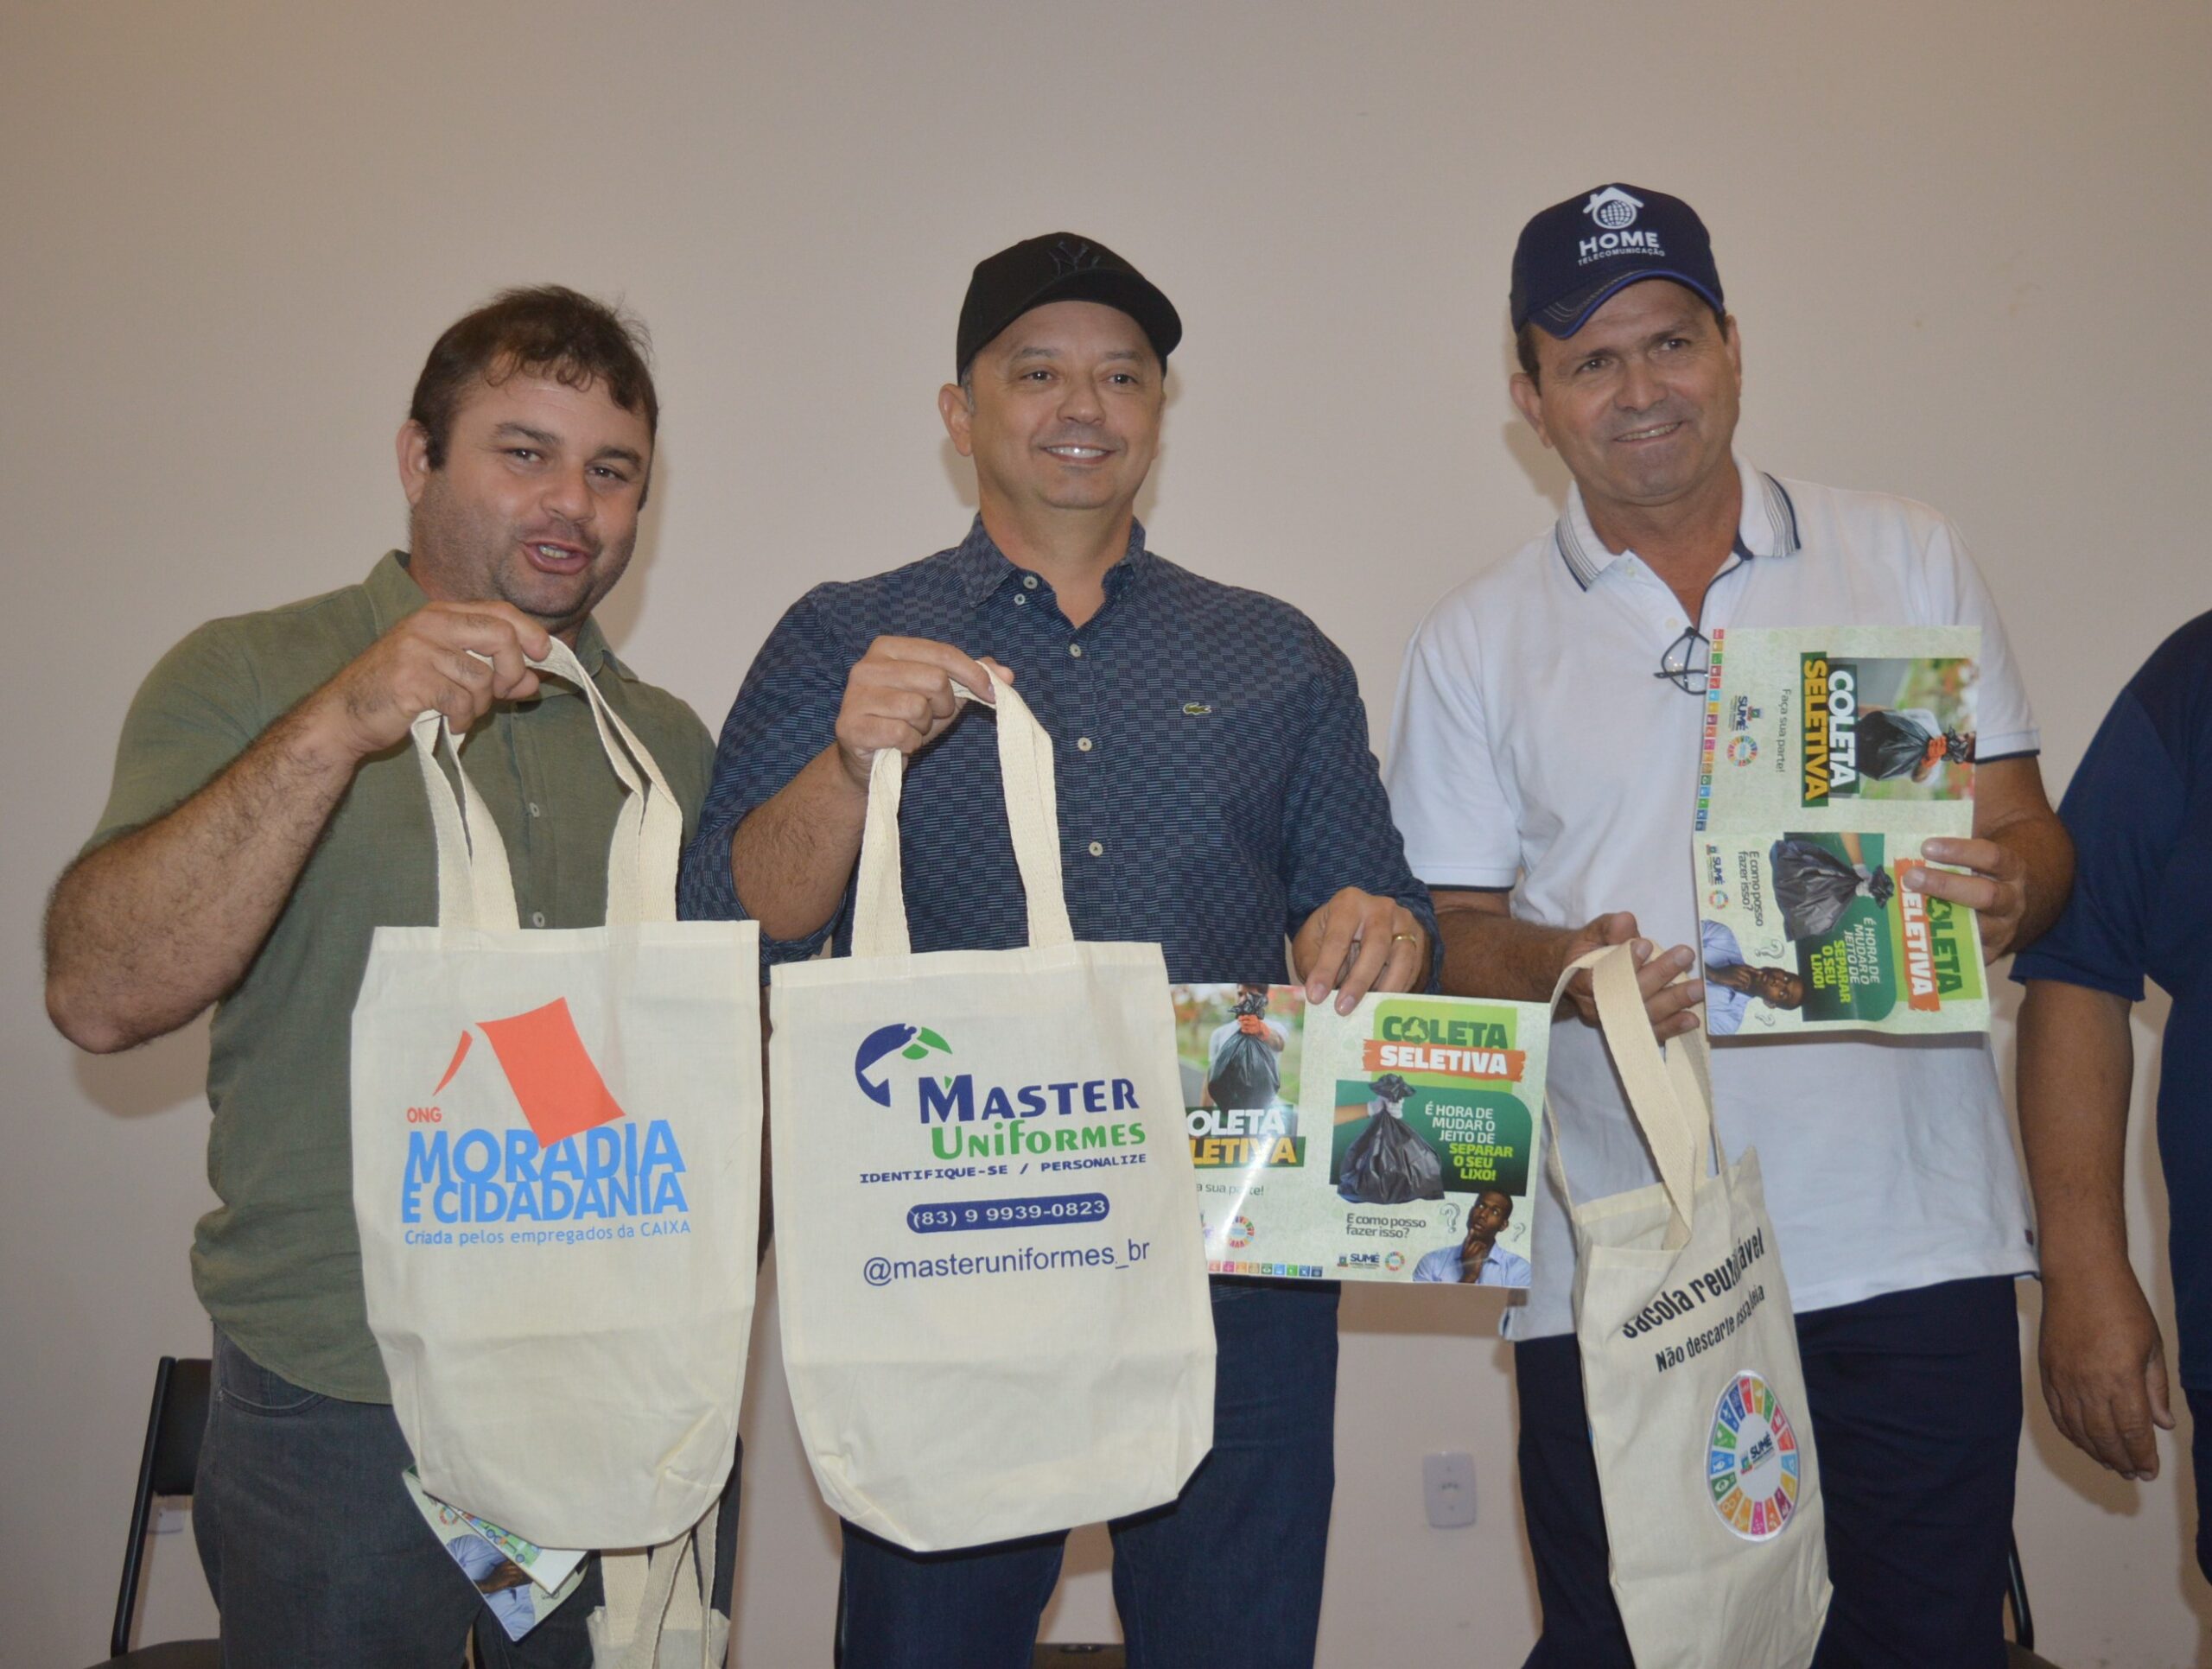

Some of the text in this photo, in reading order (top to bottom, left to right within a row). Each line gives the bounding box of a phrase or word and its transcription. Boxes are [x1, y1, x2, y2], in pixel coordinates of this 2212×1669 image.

[1578, 247, 1666, 266] TELECOMUNICAÇÃO
[1579, 231, 1660, 256] HOME
[1737, 695, 1749, 731] SUMÉ
[1776, 689, 1792, 772] Faça sua parte!
[1803, 659, 1829, 802] SELETIVA
[1827, 670, 1857, 788] COLETA
[1713, 857, 1725, 885] SUMÉ
[1738, 851, 1753, 911] fazer isso?
[1750, 860, 1760, 891] como
[1751, 892, 1764, 927] posso
[1844, 930, 1860, 984] JEITO DE
[1853, 923, 1870, 985] MUDAR O
[1865, 928, 1878, 963] HORA
[1925, 895, 1963, 994] OLETA
[1810, 954, 1826, 989] LIXO!
[1821, 945, 1837, 985] O SEU
[1834, 940, 1851, 1003] SEPARAR
[1869, 966, 1880, 984] DE
[1382, 1016, 1509, 1050] COLETA
[1380, 1045, 1508, 1076] SELETIVA
[918, 1074, 1141, 1124] MASTER
[1425, 1101, 1493, 1120] É HORA DE
[406, 1107, 442, 1123] ONG
[1187, 1108, 1286, 1136] OLETA
[1432, 1116, 1496, 1133] MUDAR O
[406, 1120, 687, 1184] MORADIA
[1190, 1137, 1297, 1164] LETIVA
[1439, 1129, 1496, 1145] JEITO DE
[1449, 1142, 1514, 1158] SEPARAR
[860, 1164, 1008, 1184] IDENTIFIQUE-SE
[1040, 1153, 1147, 1172] PERSONALIZE
[1453, 1155, 1494, 1169] O SEU
[1460, 1168, 1497, 1182] LIXO!
[402, 1171, 689, 1224] E CIDADANIA
[912, 1200, 1106, 1229] (83) 9 9939-0823
[1346, 1213, 1427, 1228] E como posso
[404, 1220, 691, 1247] Criada pelos empregados da CAIXA
[1346, 1223, 1410, 1239] fazer isso?
[863, 1239, 1150, 1286] @masteruniformes_br
[1350, 1252, 1381, 1263] SUMÉ
[1655, 1346, 1685, 1373] Não
[1750, 1430, 1773, 1459] SUMÉ
